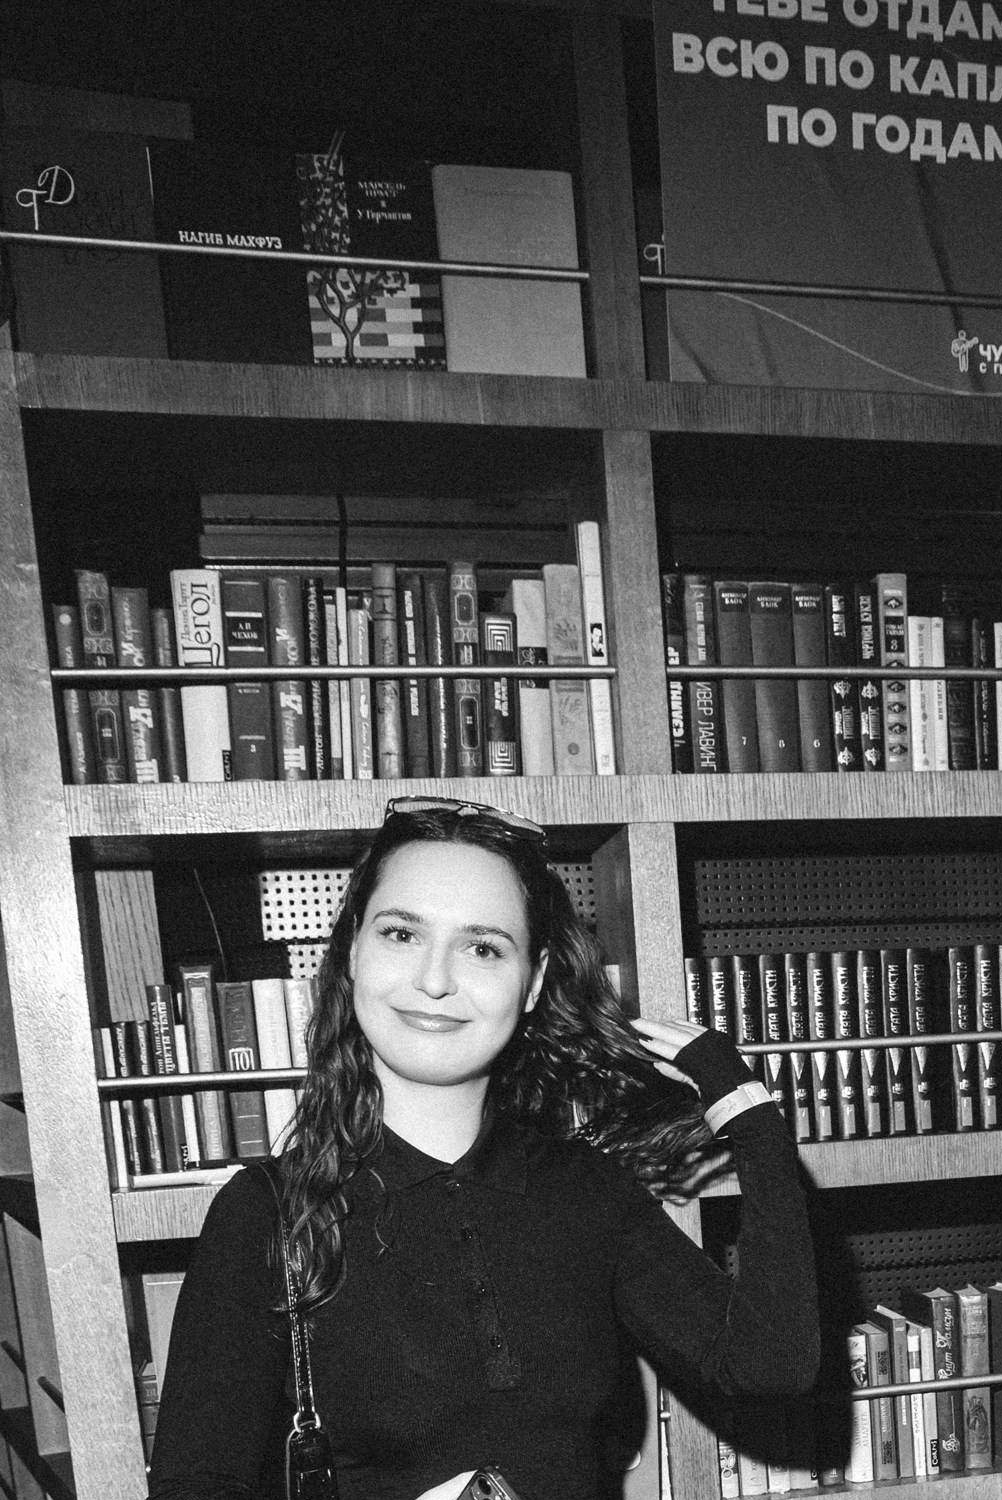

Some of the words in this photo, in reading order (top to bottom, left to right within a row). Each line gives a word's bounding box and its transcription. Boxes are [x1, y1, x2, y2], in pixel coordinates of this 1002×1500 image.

[671, 32, 790, 82] ВСЮ
[804, 45, 874, 90] ПО
[766, 104, 837, 148] ПО
[178, 229, 224, 245] НАГИБ
[226, 233, 284, 250] МАХФУЗ
[979, 362, 987, 374] С
[698, 720, 717, 772] ЛАВИНГ
[687, 973, 701, 1011] КРИСТИ
[712, 971, 726, 1010] КРИСТИ
[739, 970, 751, 1009] КРИСТИ
[765, 969, 778, 1008] КРИСТИ
[789, 968, 802, 1007] КРИСТИ
[813, 968, 825, 1007] КРИСТИ
[836, 966, 849, 1005] КРИСТИ
[862, 966, 875, 1004] КРИСТИ
[888, 964, 899, 1002] КРИСТИ
[913, 963, 926, 1001] КРИСТИ
[956, 961, 968, 999] КРИСТИ
[979, 959, 993, 997] КРИСТИ
[715, 1016, 727, 1034] АТА
[743, 1014, 755, 1041] АГАТА
[768, 1013, 780, 1041] АГАТА
[791, 1011, 804, 1039] АГАТА
[815, 1011, 828, 1039] АГАТА
[839, 1010, 851, 1037] АГАТА
[864, 1009, 876, 1035] АГАТА
[890, 1007, 901, 1034] АГАТА
[915, 1006, 927, 1033] АГАТА
[957, 1003, 969, 1031] АГАТА
[981, 1002, 994, 1029] АГАТА
[234, 1050, 250, 1070] 10
